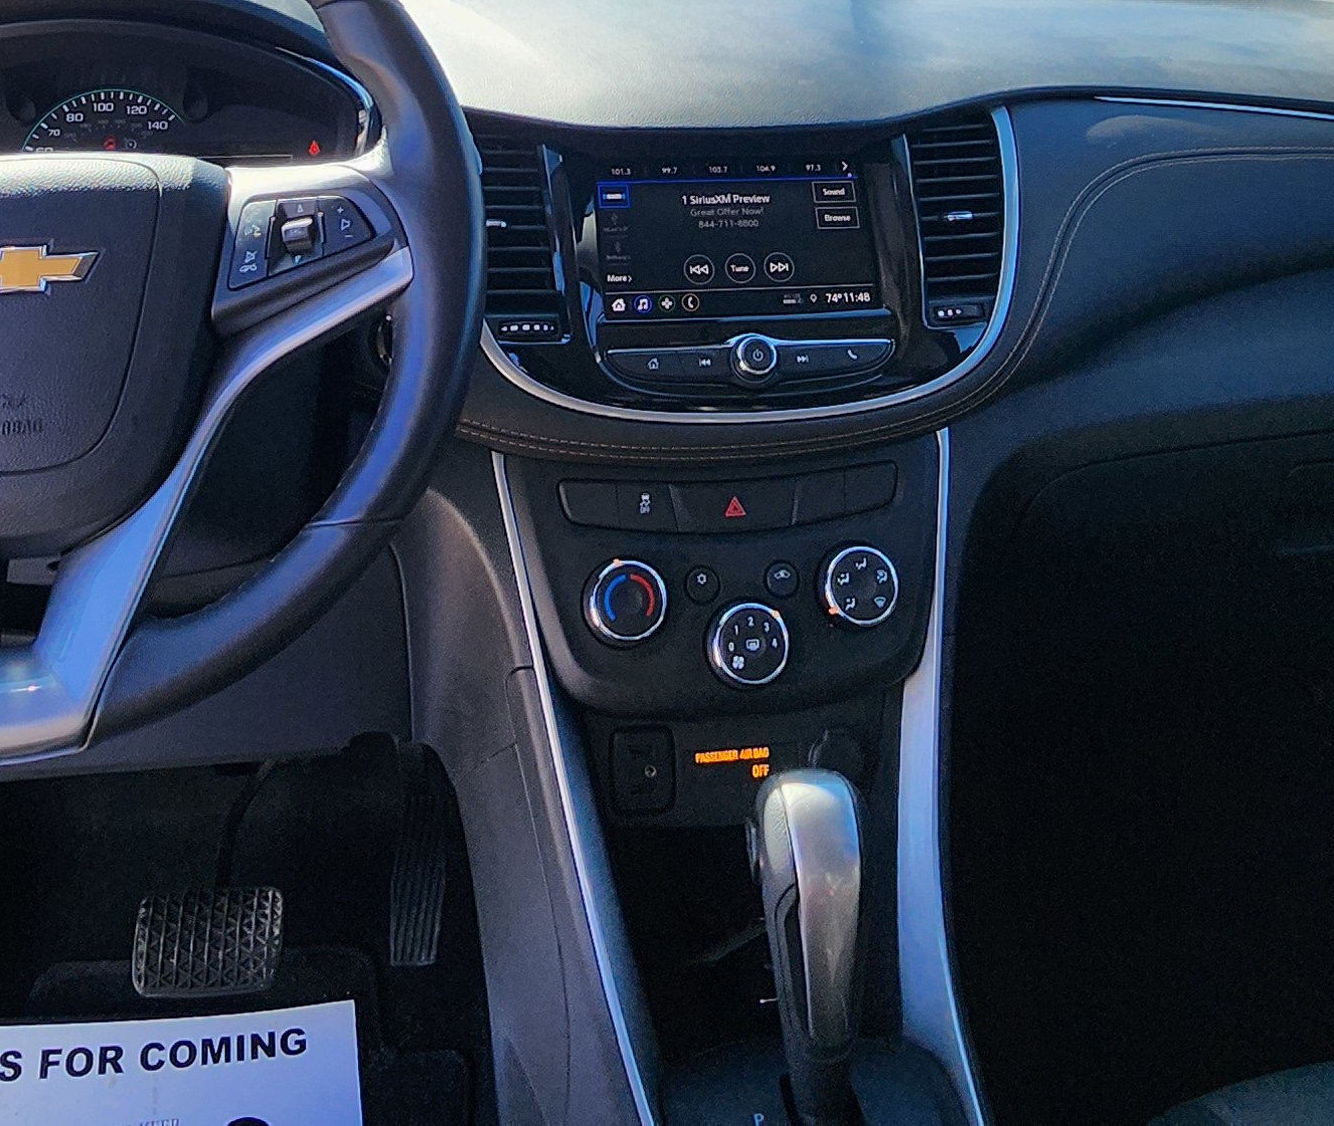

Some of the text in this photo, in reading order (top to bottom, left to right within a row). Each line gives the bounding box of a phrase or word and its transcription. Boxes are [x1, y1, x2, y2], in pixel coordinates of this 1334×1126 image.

[93, 103, 114, 112] 100
[126, 105, 147, 115] 120
[66, 113, 83, 123] 80
[148, 121, 168, 131] 140
[48, 128, 61, 137] 70
[822, 188, 845, 196] Sound
[689, 193, 731, 205] SiriusXM
[732, 194, 770, 204] Preview
[607, 274, 627, 282] More
[843, 292, 870, 302] 11:48
[747, 616, 754, 626] 2
[734, 624, 739, 635] 1
[763, 622, 770, 632] 3
[728, 642, 735, 652] 0
[771, 638, 778, 648] 4
[695, 746, 769, 764] PASSENGER AIR BAG
[752, 764, 769, 778] OFF
[38, 1044, 123, 1080] FOR
[139, 1027, 307, 1072] COMING
[753, 1113, 764, 1126] P
